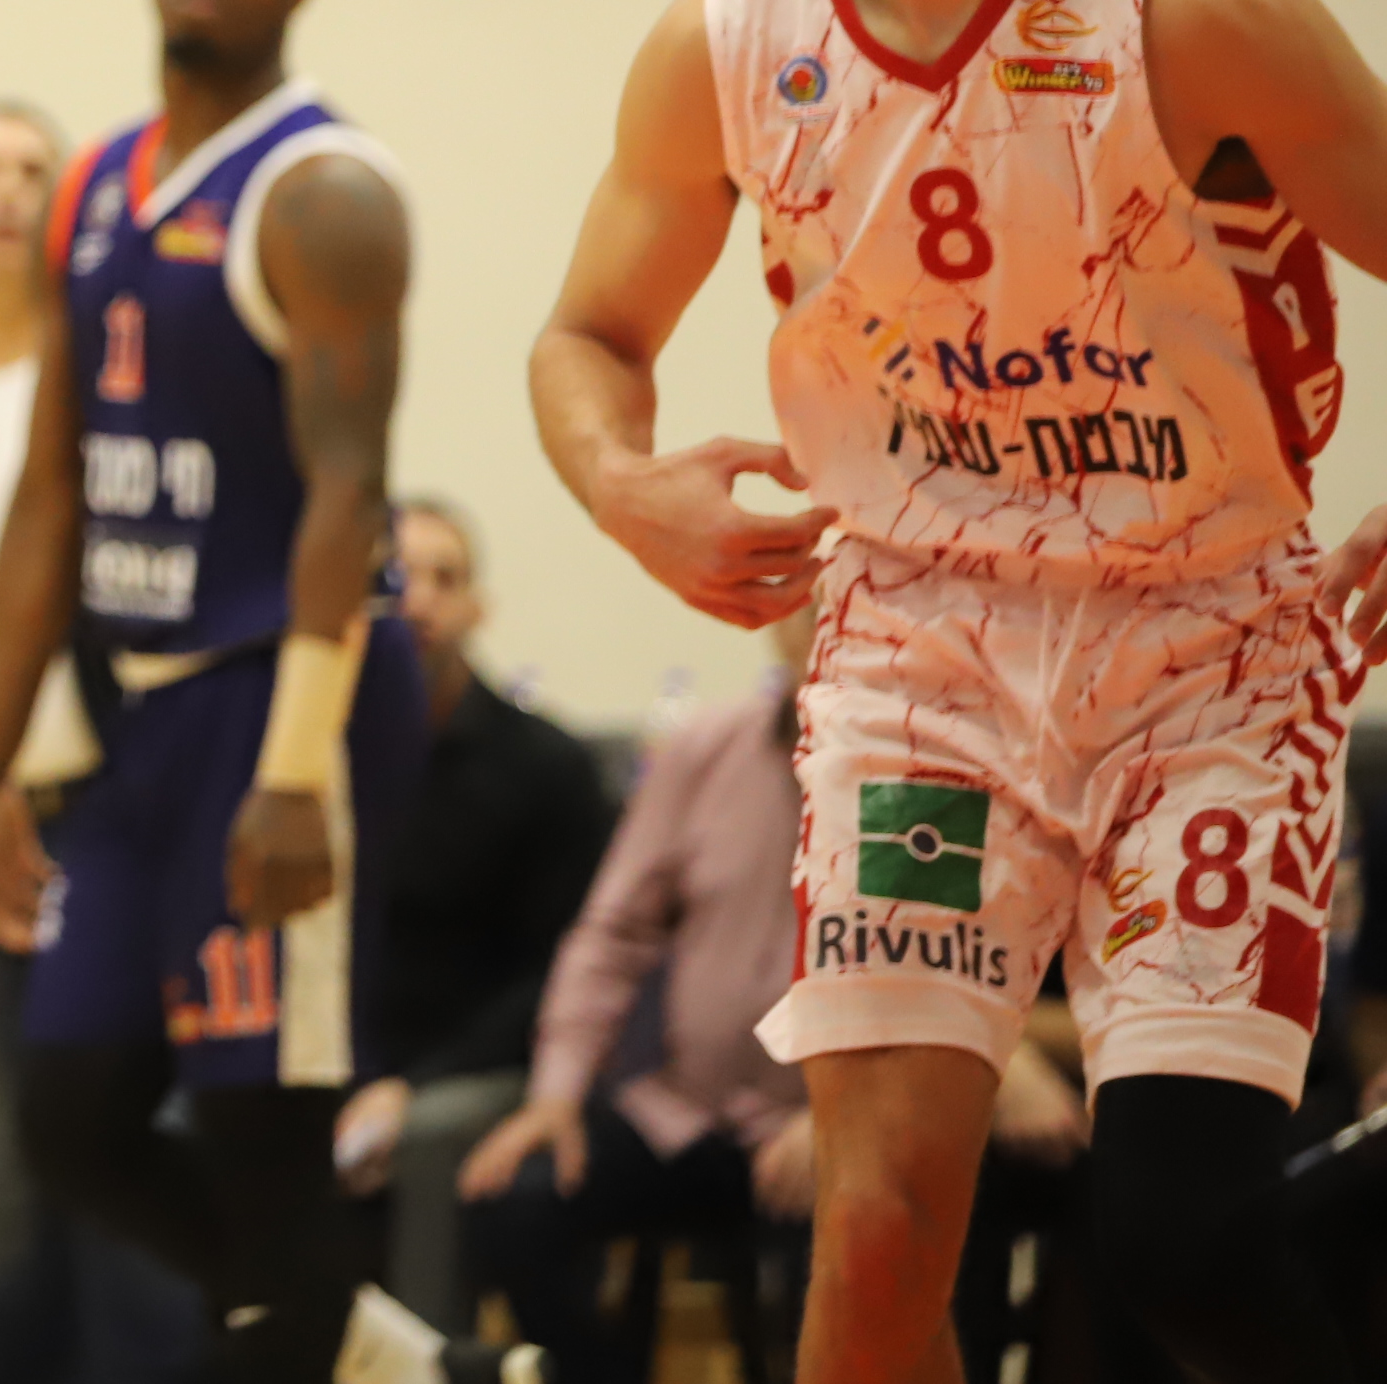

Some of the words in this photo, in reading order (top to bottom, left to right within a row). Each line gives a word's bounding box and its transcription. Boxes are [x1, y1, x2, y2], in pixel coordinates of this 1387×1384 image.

[910, 168, 994, 282] 8
[932, 326, 1154, 391] Nofar
[1175, 807, 1250, 928] 8
[199, 923, 278, 1039] 11
[815, 909, 1010, 989] Rivulis
